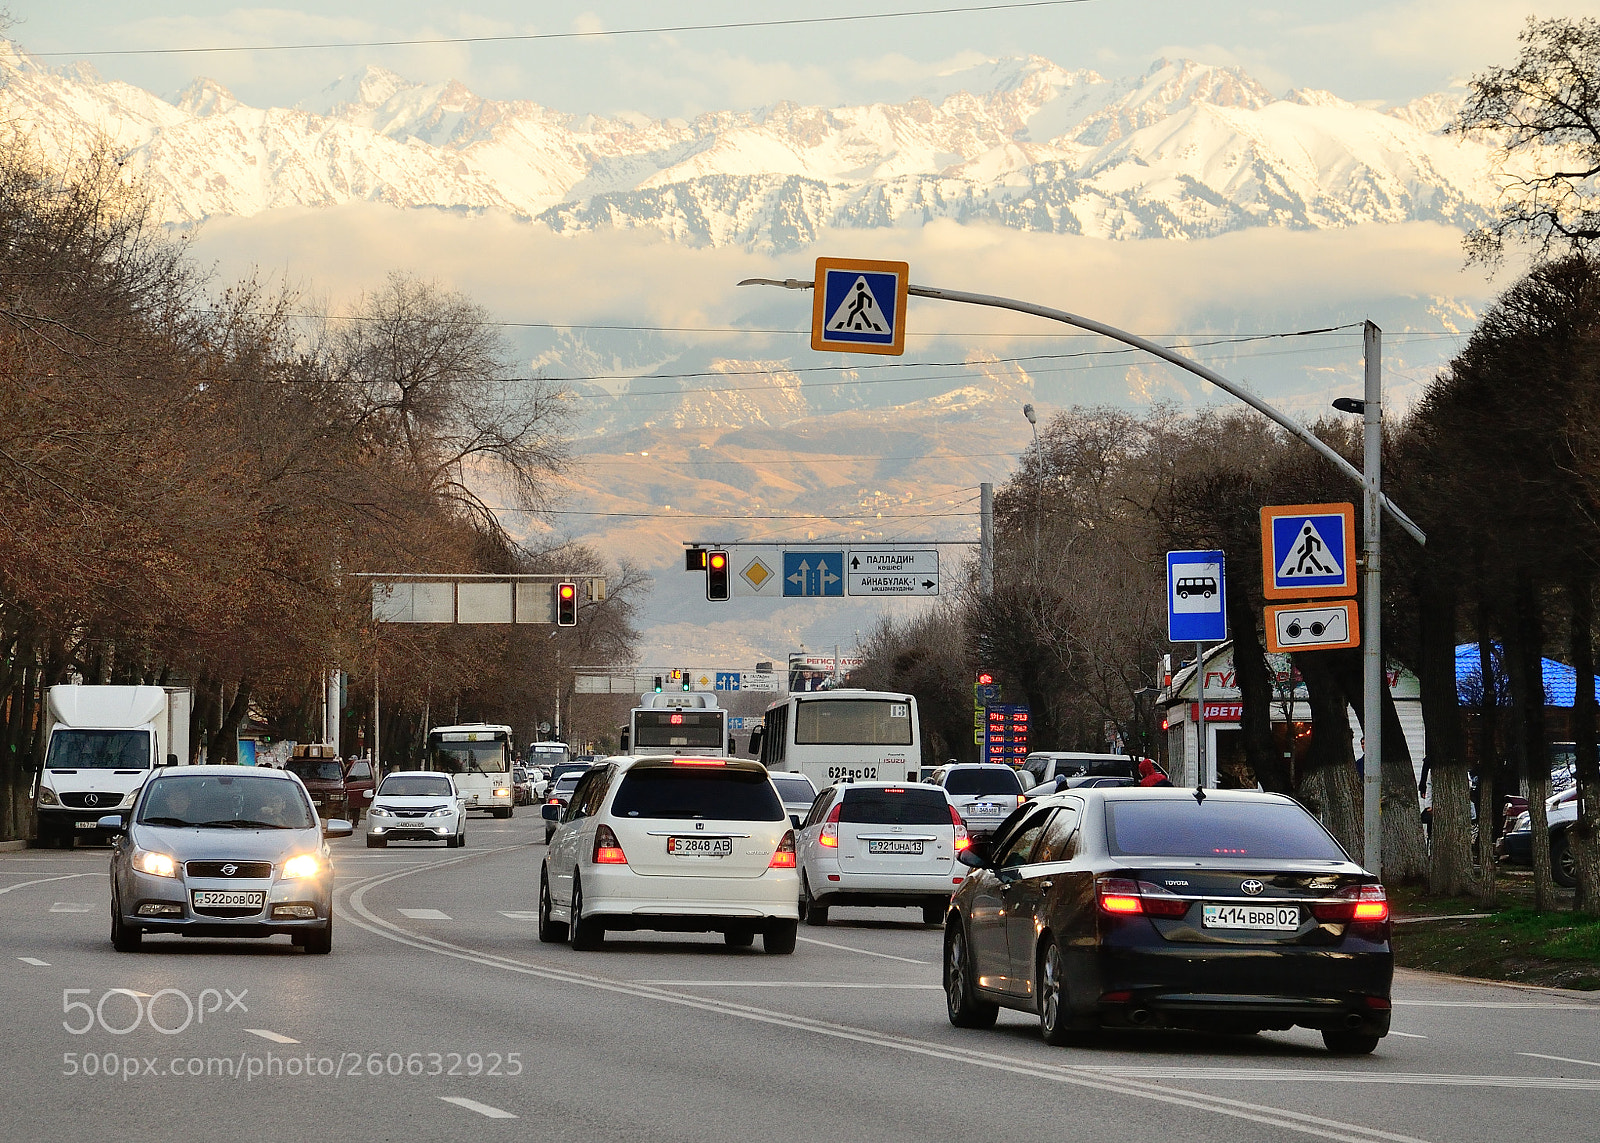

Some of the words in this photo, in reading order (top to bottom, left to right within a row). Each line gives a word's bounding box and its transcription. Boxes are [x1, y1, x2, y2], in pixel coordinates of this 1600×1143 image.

[866, 555, 914, 564] ПАЛЛАДИН
[806, 658, 863, 666] РЕГИСТАТОР
[671, 670, 681, 680] 16
[892, 706, 906, 717] 13
[685, 840, 710, 851] 2848
[713, 840, 731, 851] AB
